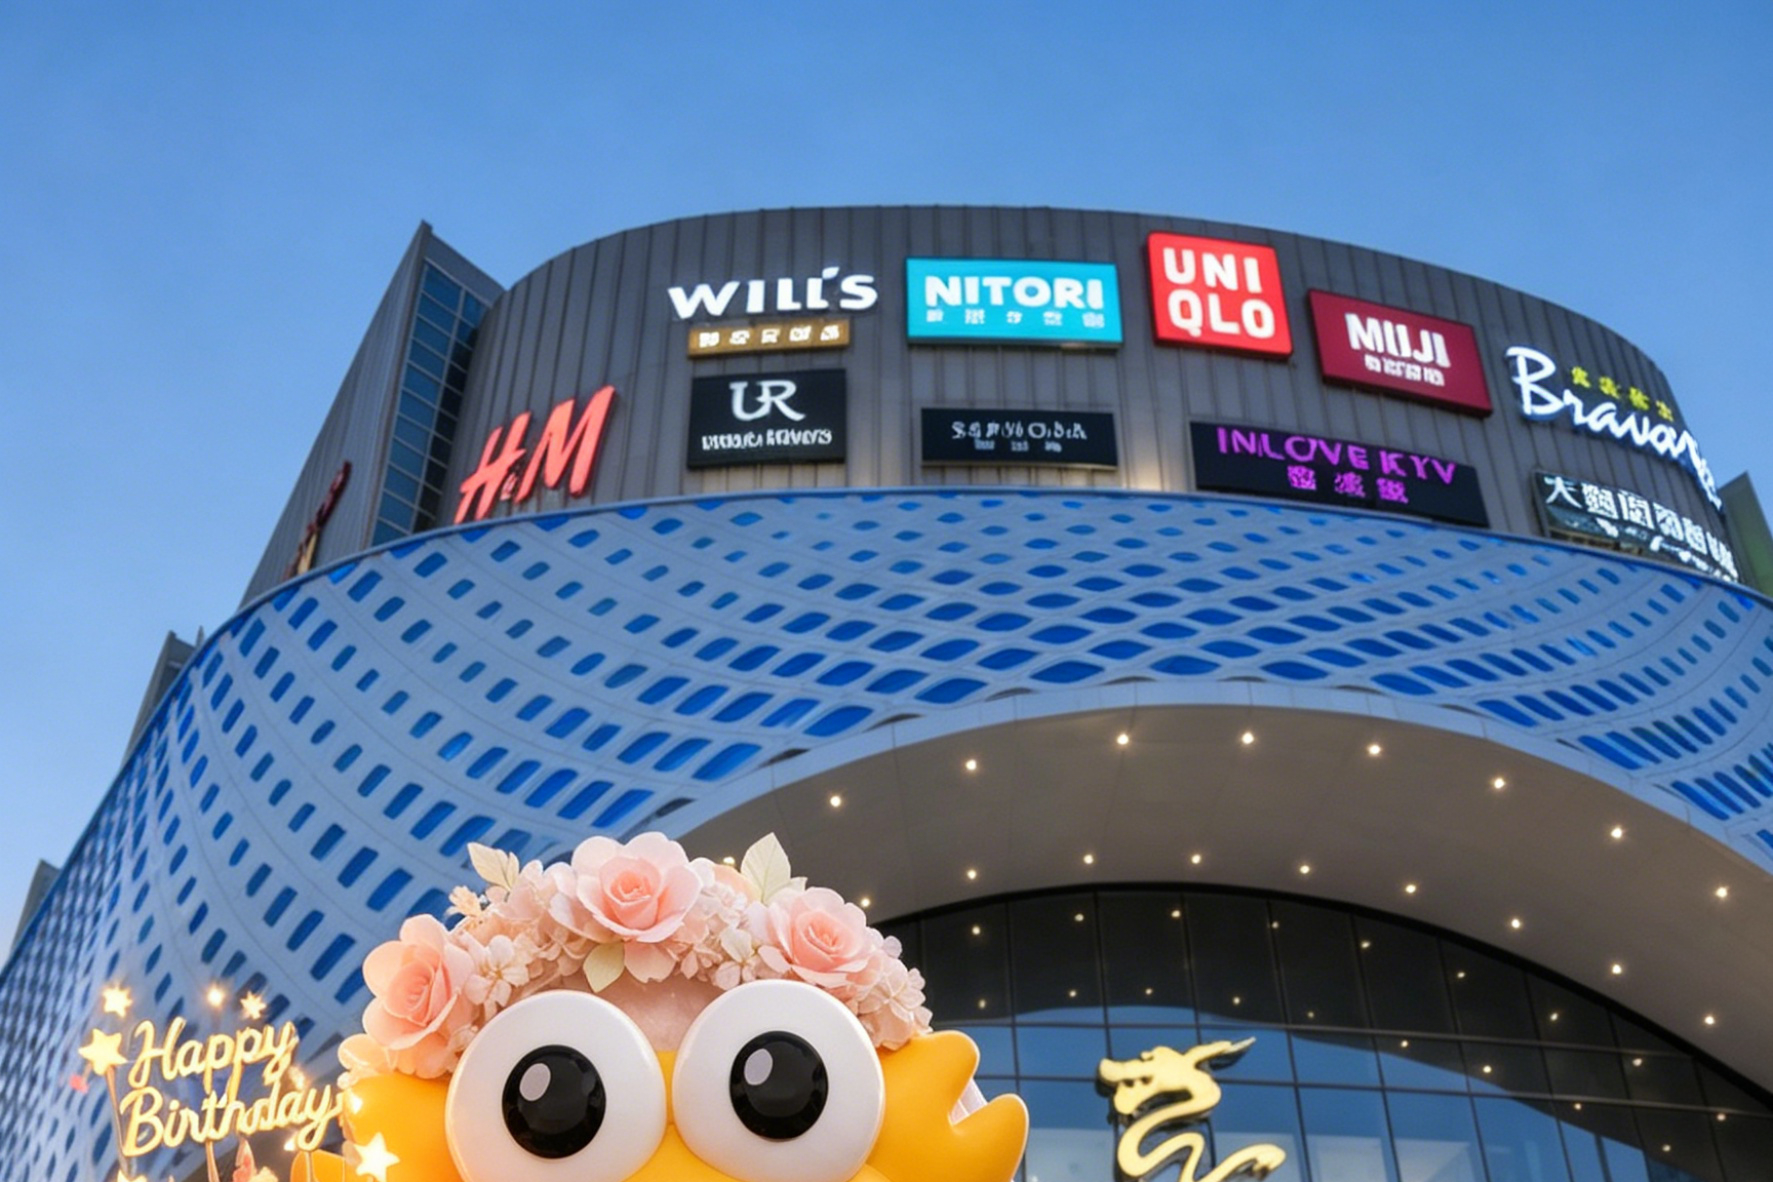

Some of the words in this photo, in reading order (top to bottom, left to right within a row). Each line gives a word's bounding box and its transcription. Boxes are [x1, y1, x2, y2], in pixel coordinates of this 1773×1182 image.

[925, 275, 1104, 310] NITORI
[1163, 247, 1262, 293] UNI
[1168, 289, 1275, 338] QLO
[1345, 313, 1451, 368] MUJI
[729, 379, 806, 422] UR
[453, 385, 616, 525] H&M
[1217, 426, 1369, 470] INLOVE
[128, 1016, 299, 1095] Happy
